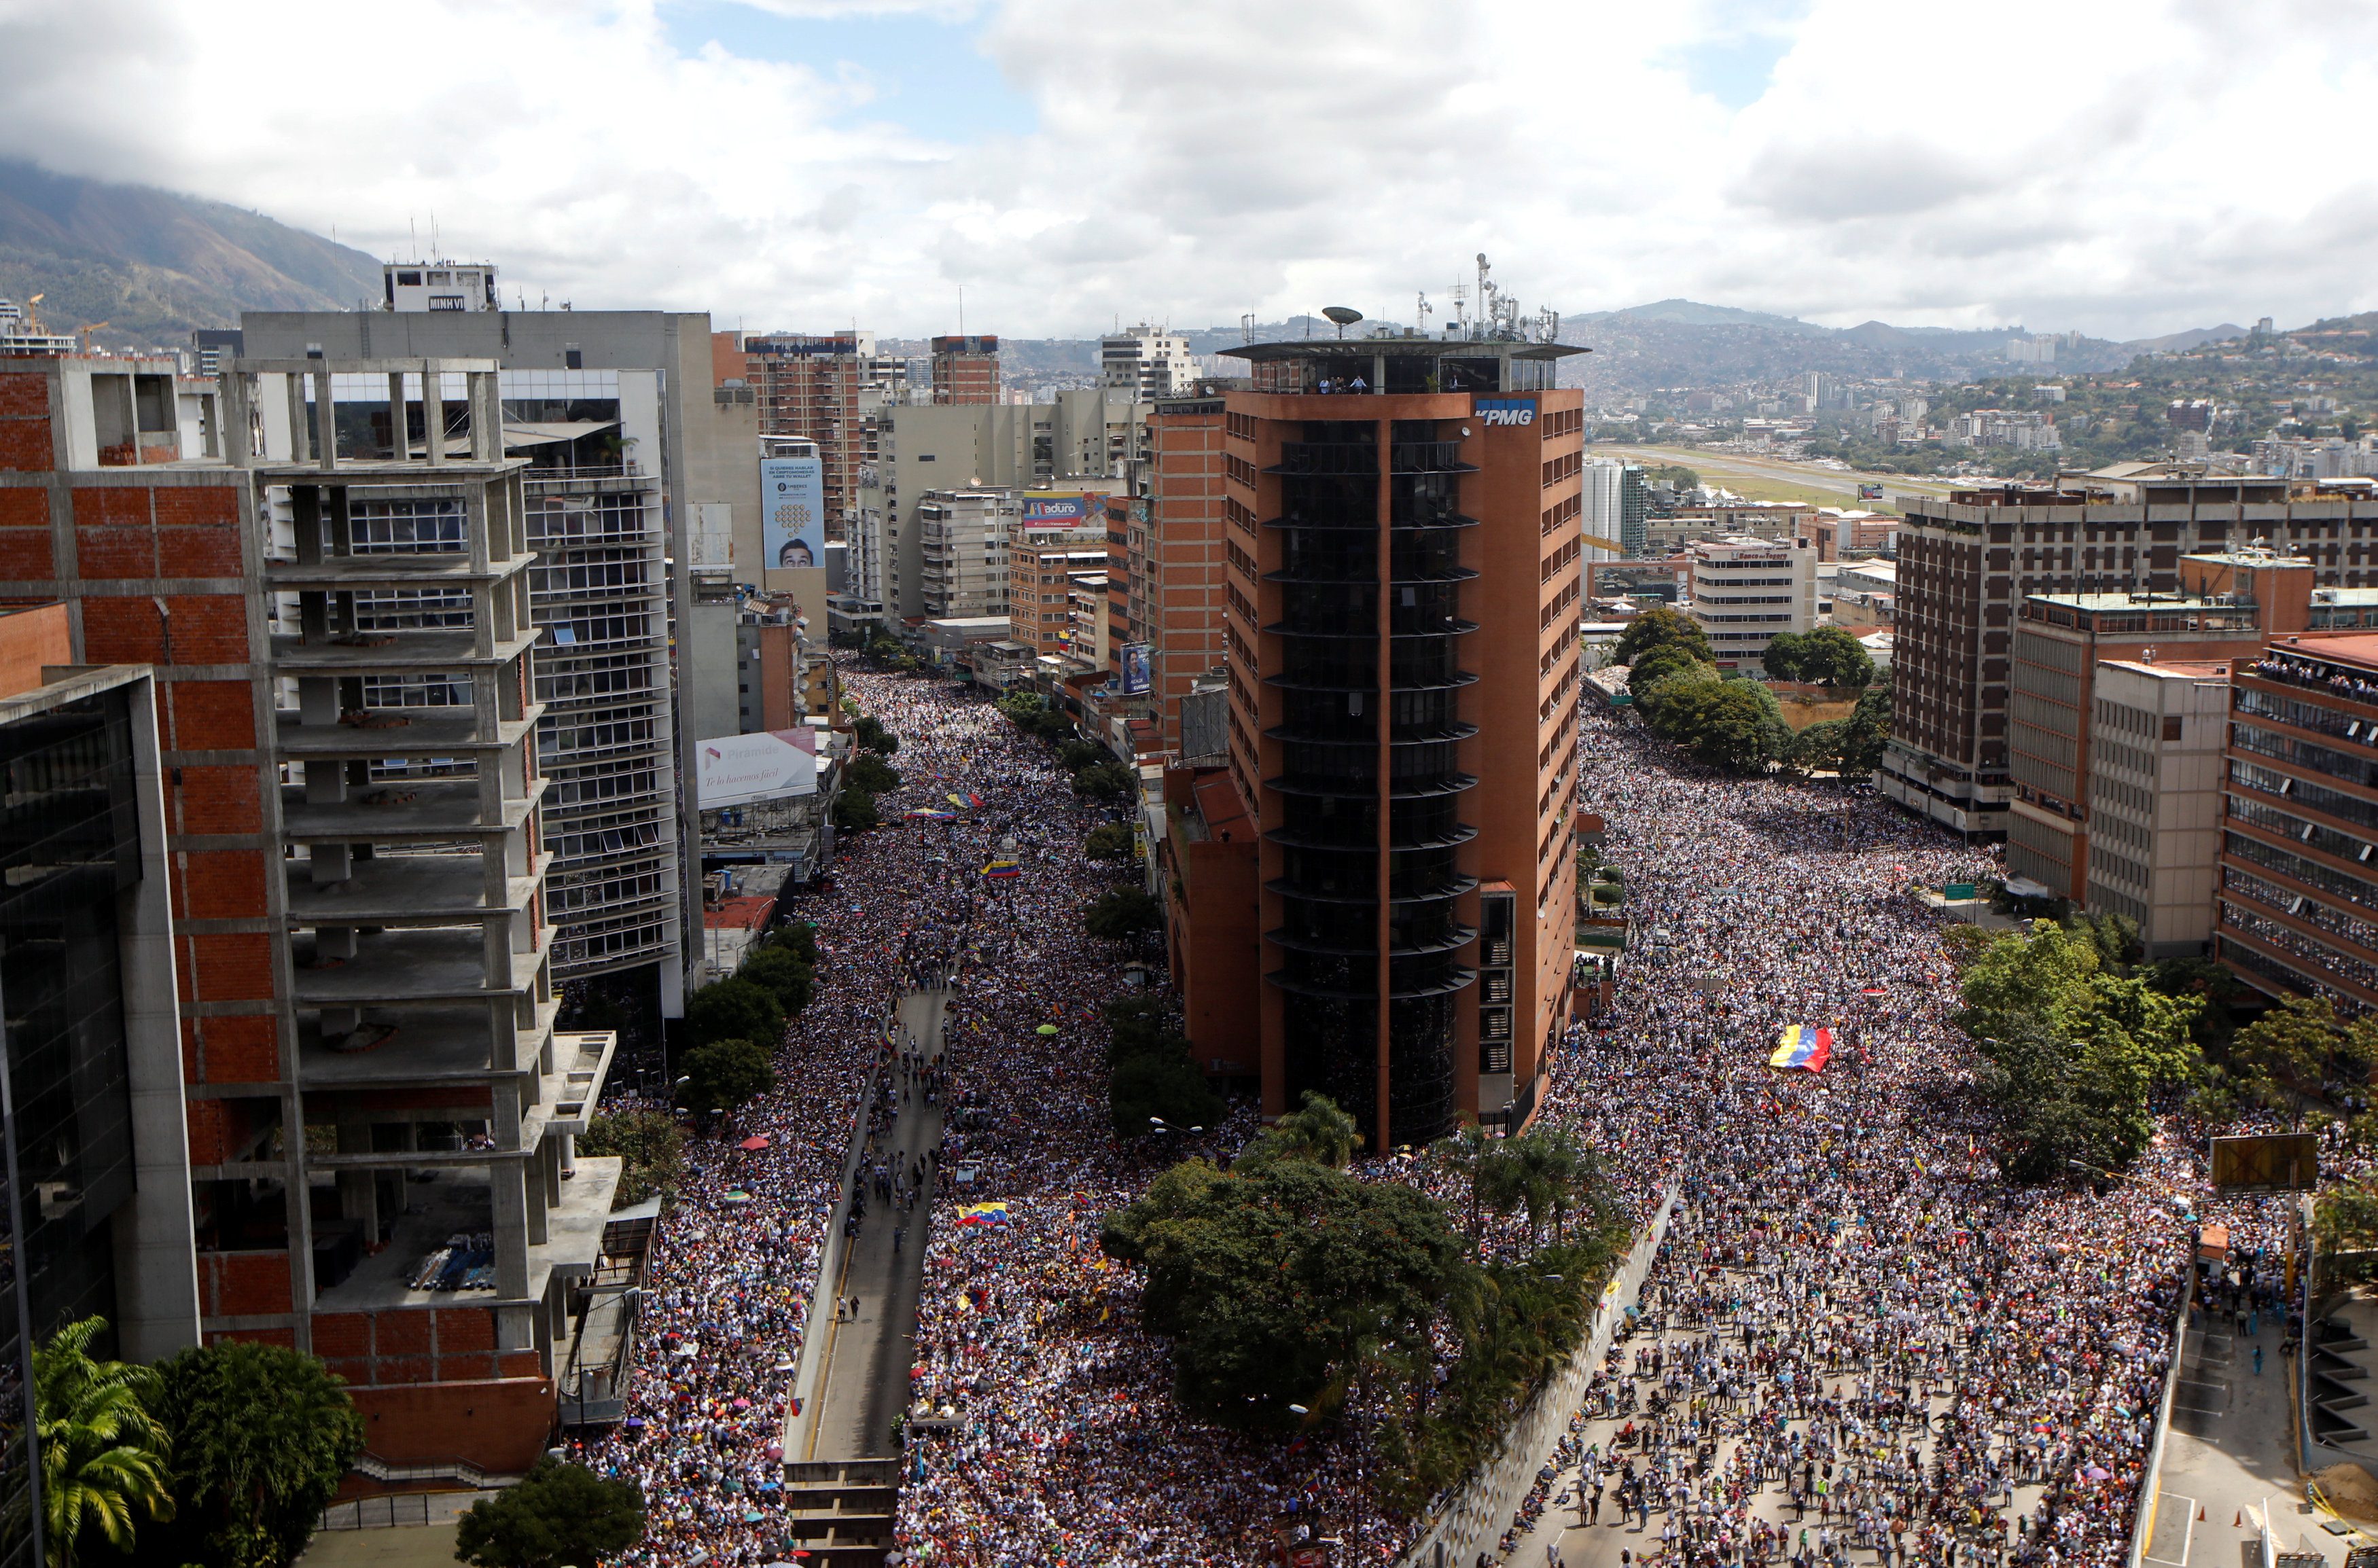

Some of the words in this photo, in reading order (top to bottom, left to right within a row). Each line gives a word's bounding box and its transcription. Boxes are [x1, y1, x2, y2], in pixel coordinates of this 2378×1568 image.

[1029, 502, 1076, 516] Maduro
[728, 745, 779, 760] Pirámide
[706, 777, 715, 787] Te
[717, 776, 724, 785] lo
[726, 773, 759, 784] hacemos
[760, 768, 779, 781] fácil
